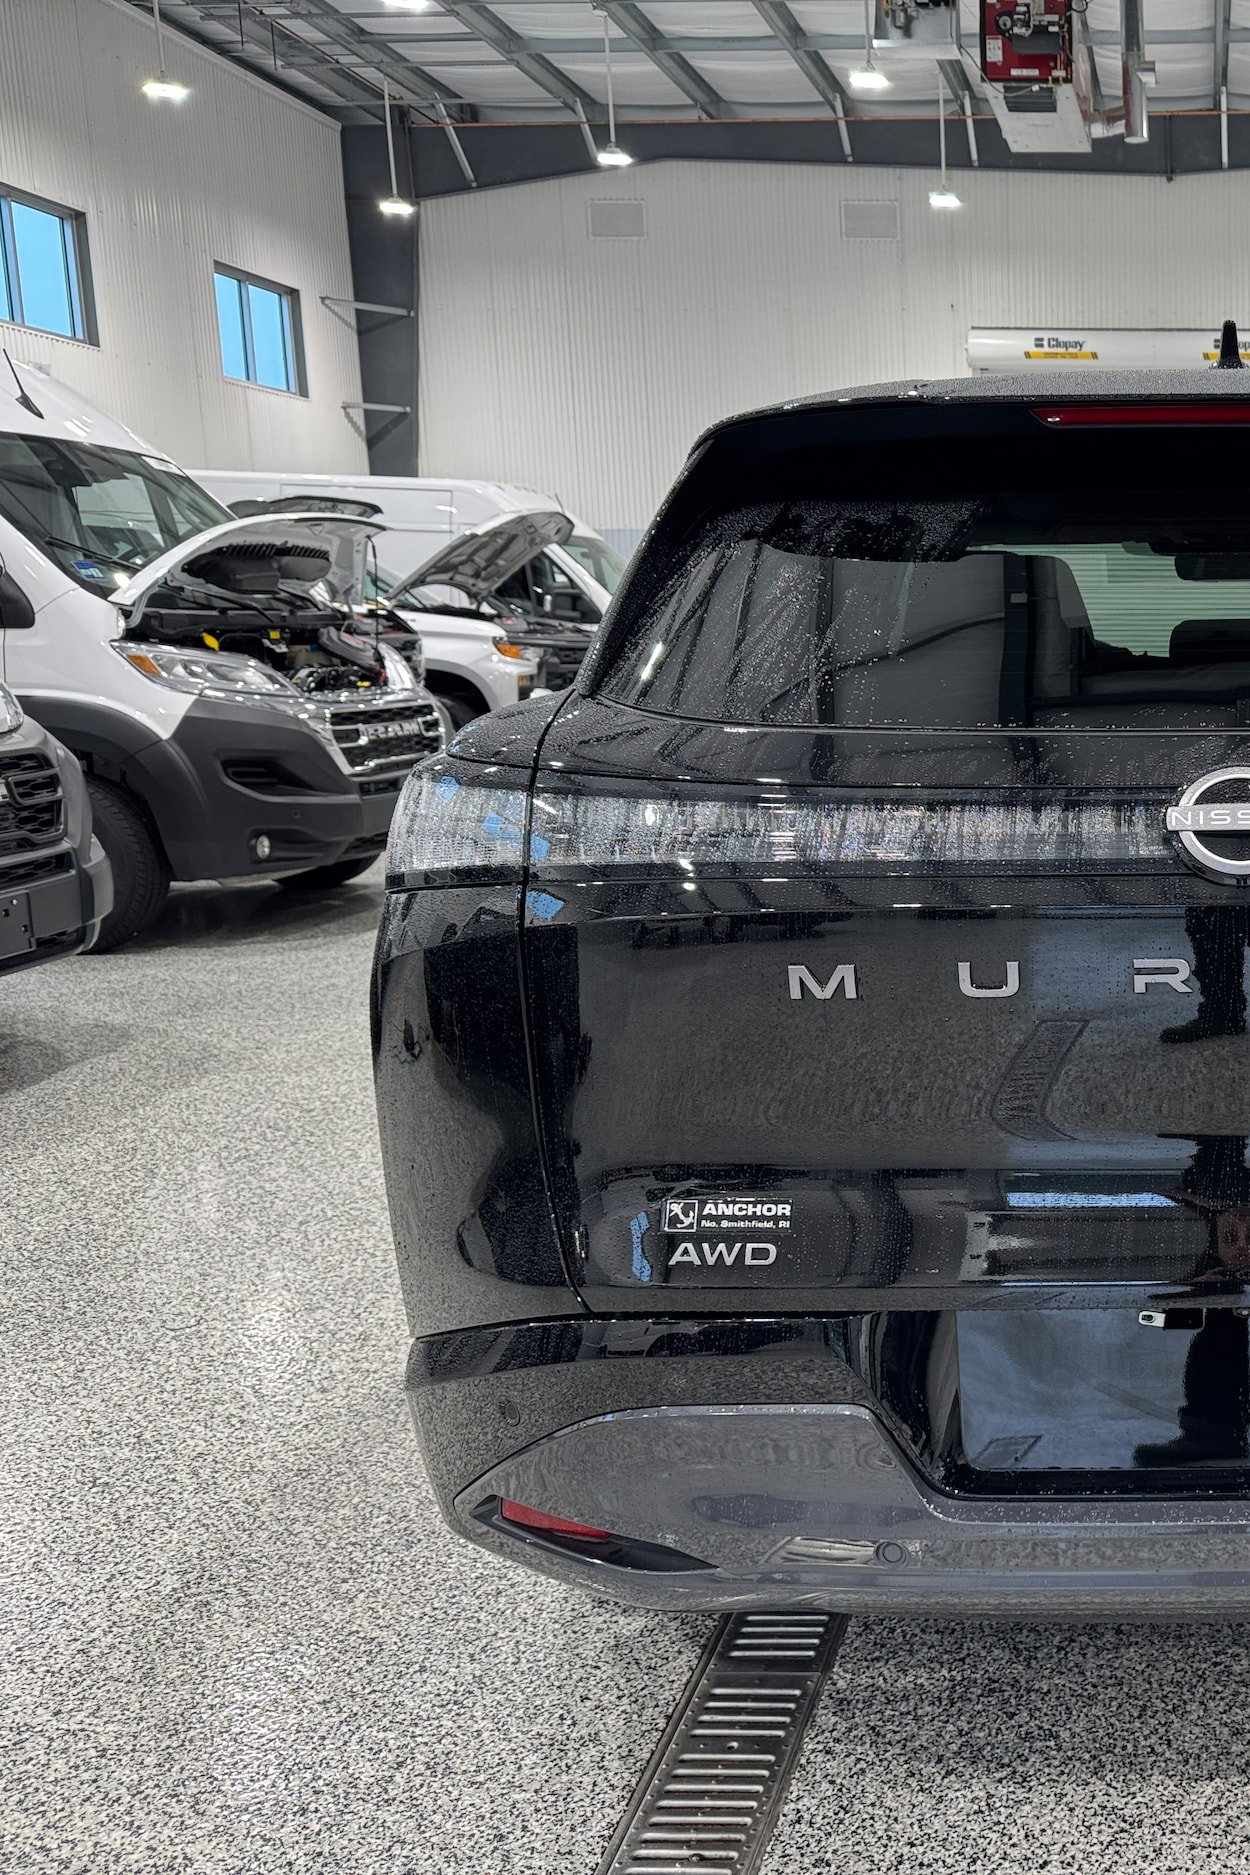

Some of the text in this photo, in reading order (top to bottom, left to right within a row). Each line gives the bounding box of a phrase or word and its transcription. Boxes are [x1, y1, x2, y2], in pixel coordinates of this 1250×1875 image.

[1047, 338, 1084, 351] Clopay
[368, 722, 419, 739] RAM
[701, 1203, 792, 1216] ANCHOR
[701, 1220, 791, 1229] No. Smithfield, RI
[667, 1242, 777, 1266] AWD
